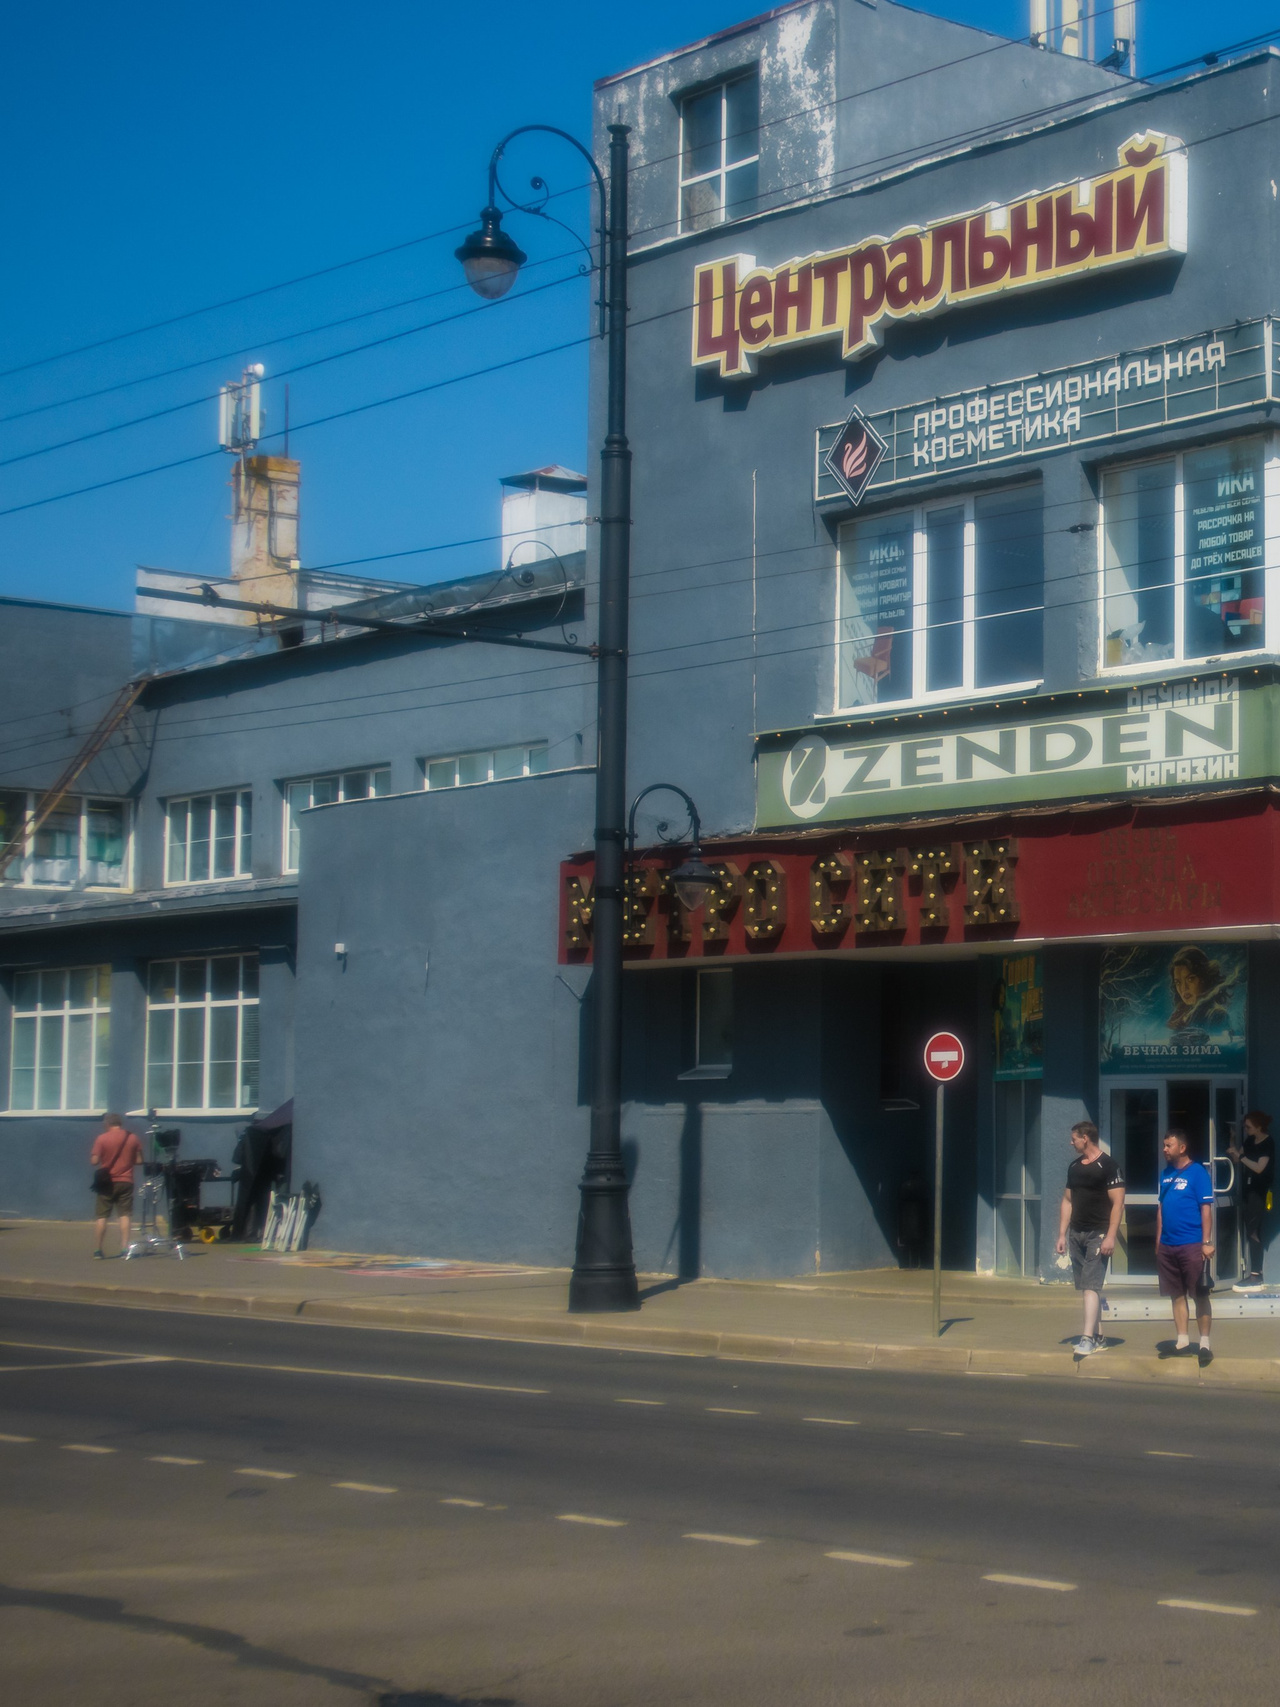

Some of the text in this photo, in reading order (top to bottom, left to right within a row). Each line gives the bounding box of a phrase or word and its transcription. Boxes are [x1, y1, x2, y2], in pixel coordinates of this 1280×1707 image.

[698, 142, 1166, 372] Центральный
[913, 340, 1226, 439] ПРОФЕССИОНАЛЬНАЯ
[912, 405, 1081, 467] КОСМЕТИКА
[1217, 469, 1255, 497] ИКА
[1197, 510, 1255, 531] РАССРОЧКА НА
[1198, 529, 1254, 549] ЛЮБОЙ ТОВАР
[1190, 545, 1263, 570] ДО ТРЁХ МЕСЯЦЕВ
[878, 577, 907, 592] КРОВАТИ
[879, 591, 912, 605] ГАРНИТУР
[1127, 676, 1239, 713] ОБУВНОЙ
[841, 702, 1233, 794] ZENDEN
[1126, 754, 1239, 788] МАГАЗИН
[810, 838, 1020, 935] СИТИ
[1123, 1045, 1222, 1056] ВЕЧНАЯ ЗИМА
